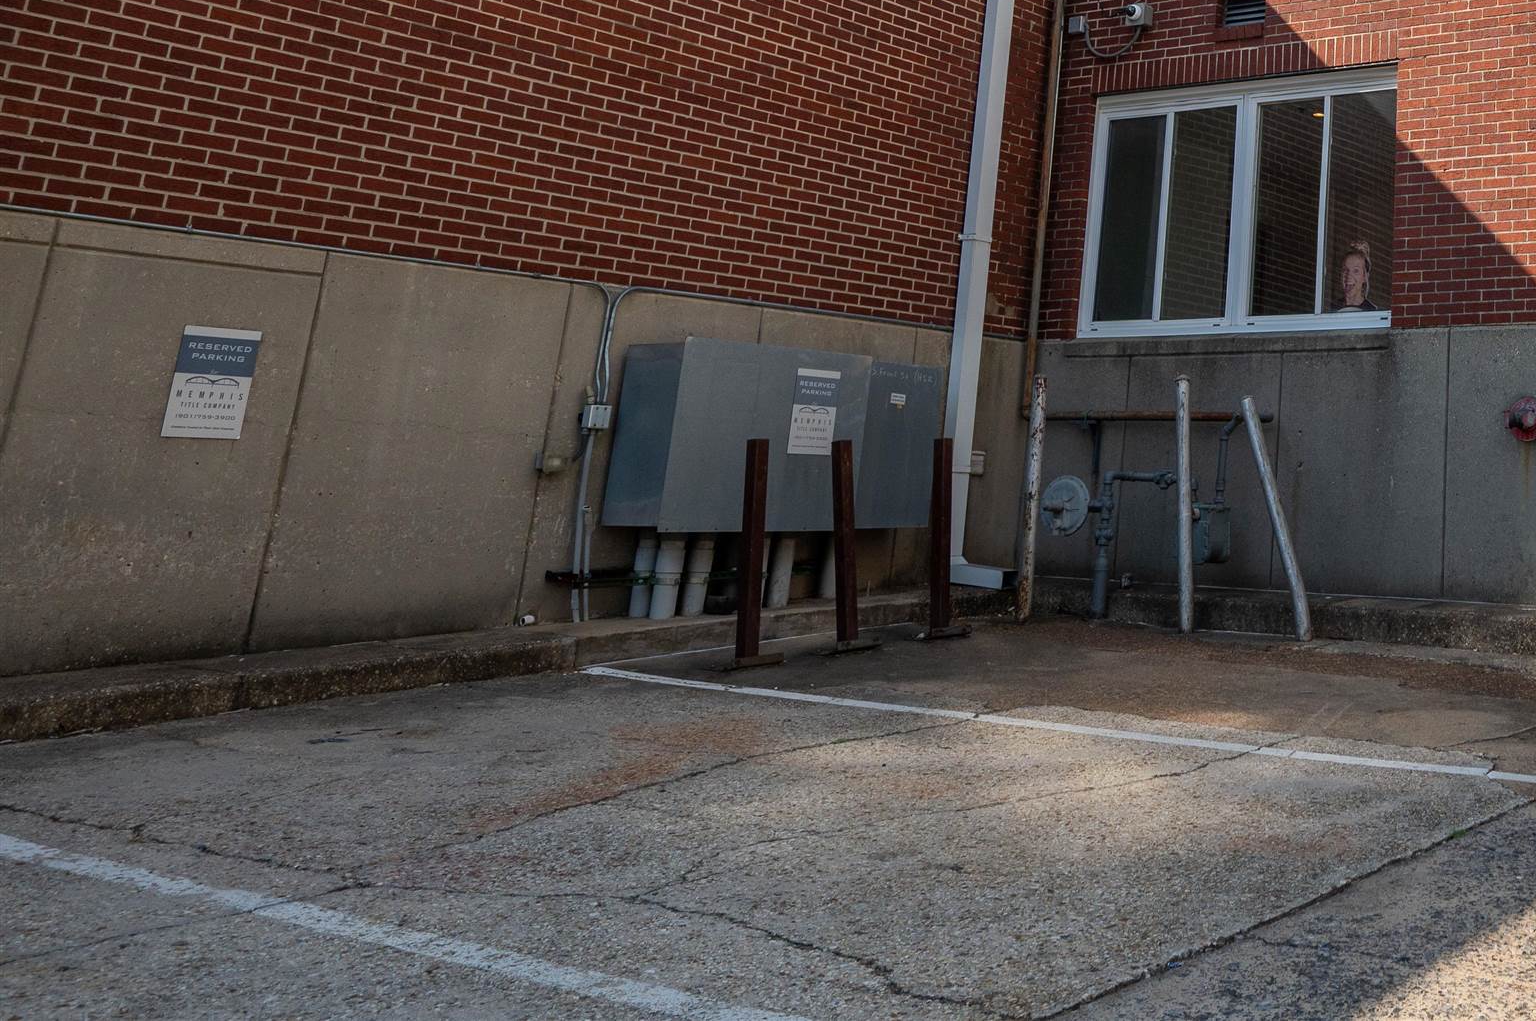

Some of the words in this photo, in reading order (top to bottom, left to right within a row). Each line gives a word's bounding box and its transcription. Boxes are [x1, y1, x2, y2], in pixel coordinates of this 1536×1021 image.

[188, 341, 253, 353] RESERVED
[191, 352, 246, 363] PARKING
[799, 380, 836, 389] RESERVED
[176, 389, 244, 401] MEMPHIS
[801, 388, 832, 397] PARKING
[180, 401, 199, 409] TITLE
[203, 402, 236, 410] COMPANY
